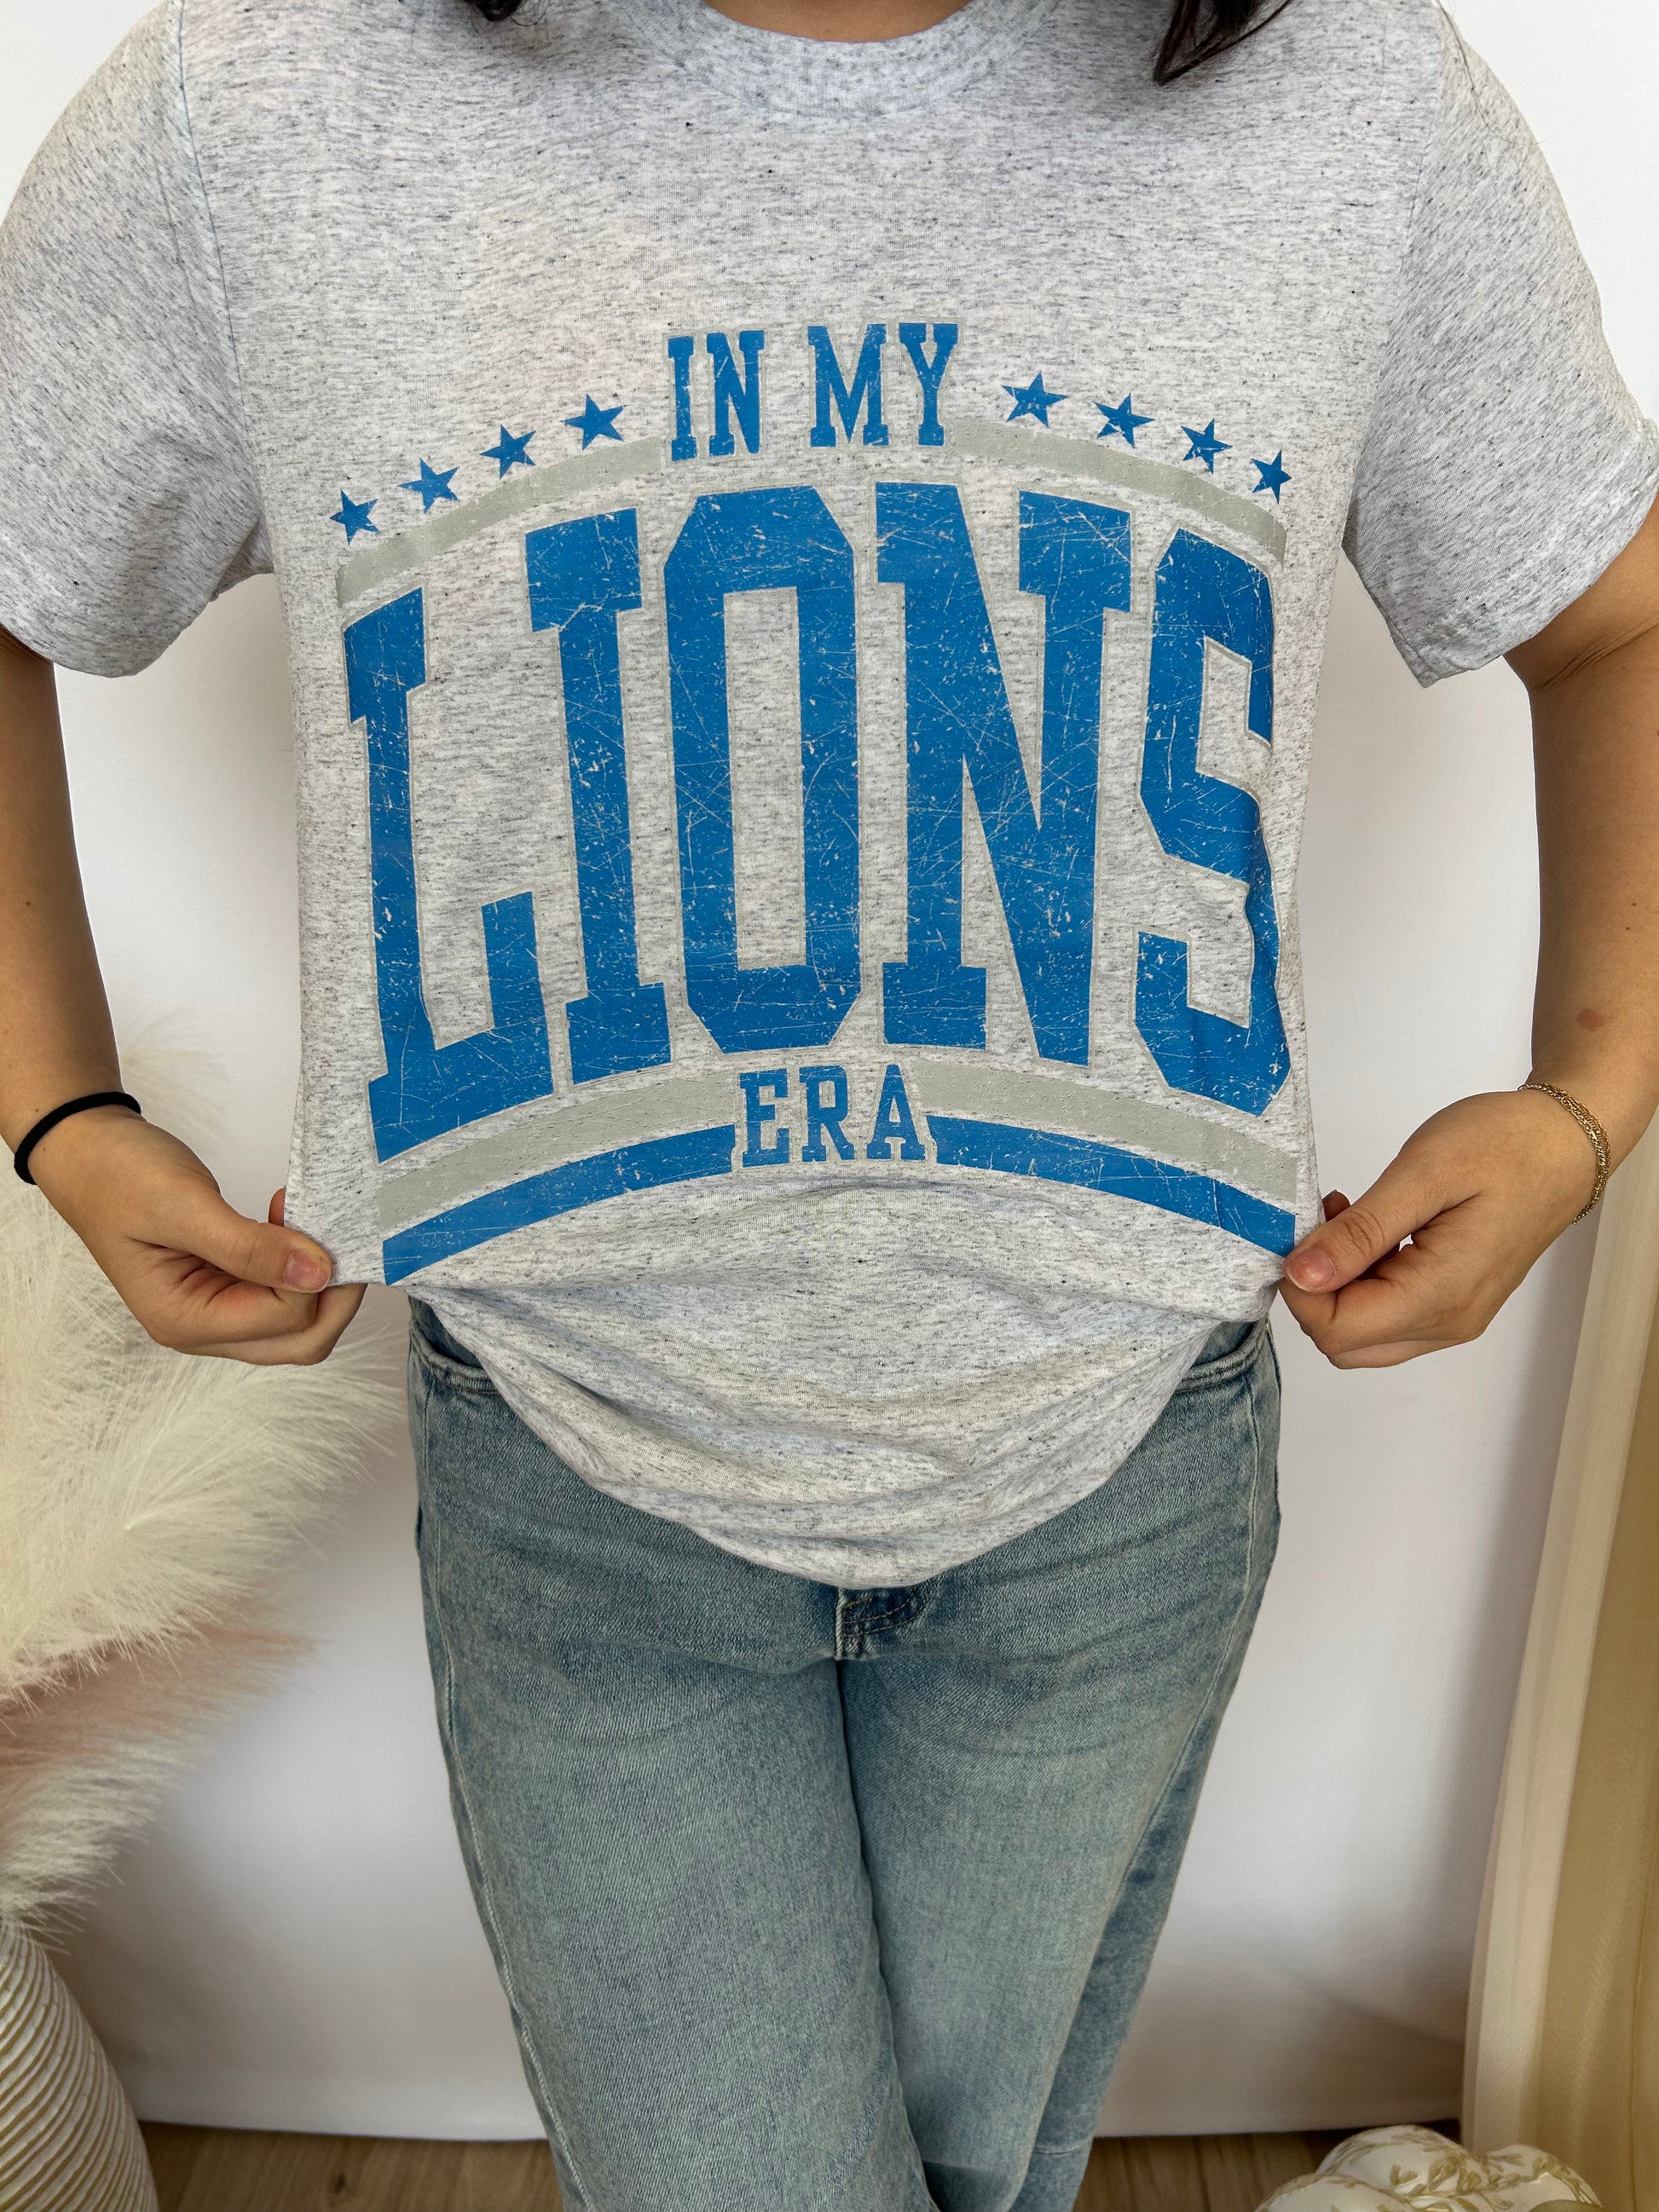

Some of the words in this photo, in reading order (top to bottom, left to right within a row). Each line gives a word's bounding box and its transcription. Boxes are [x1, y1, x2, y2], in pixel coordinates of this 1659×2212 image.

[668, 330, 765, 461] IN
[807, 322, 958, 448] MY
[344, 482, 1292, 1163] LIONS
[739, 1064, 926, 1168] ERA
